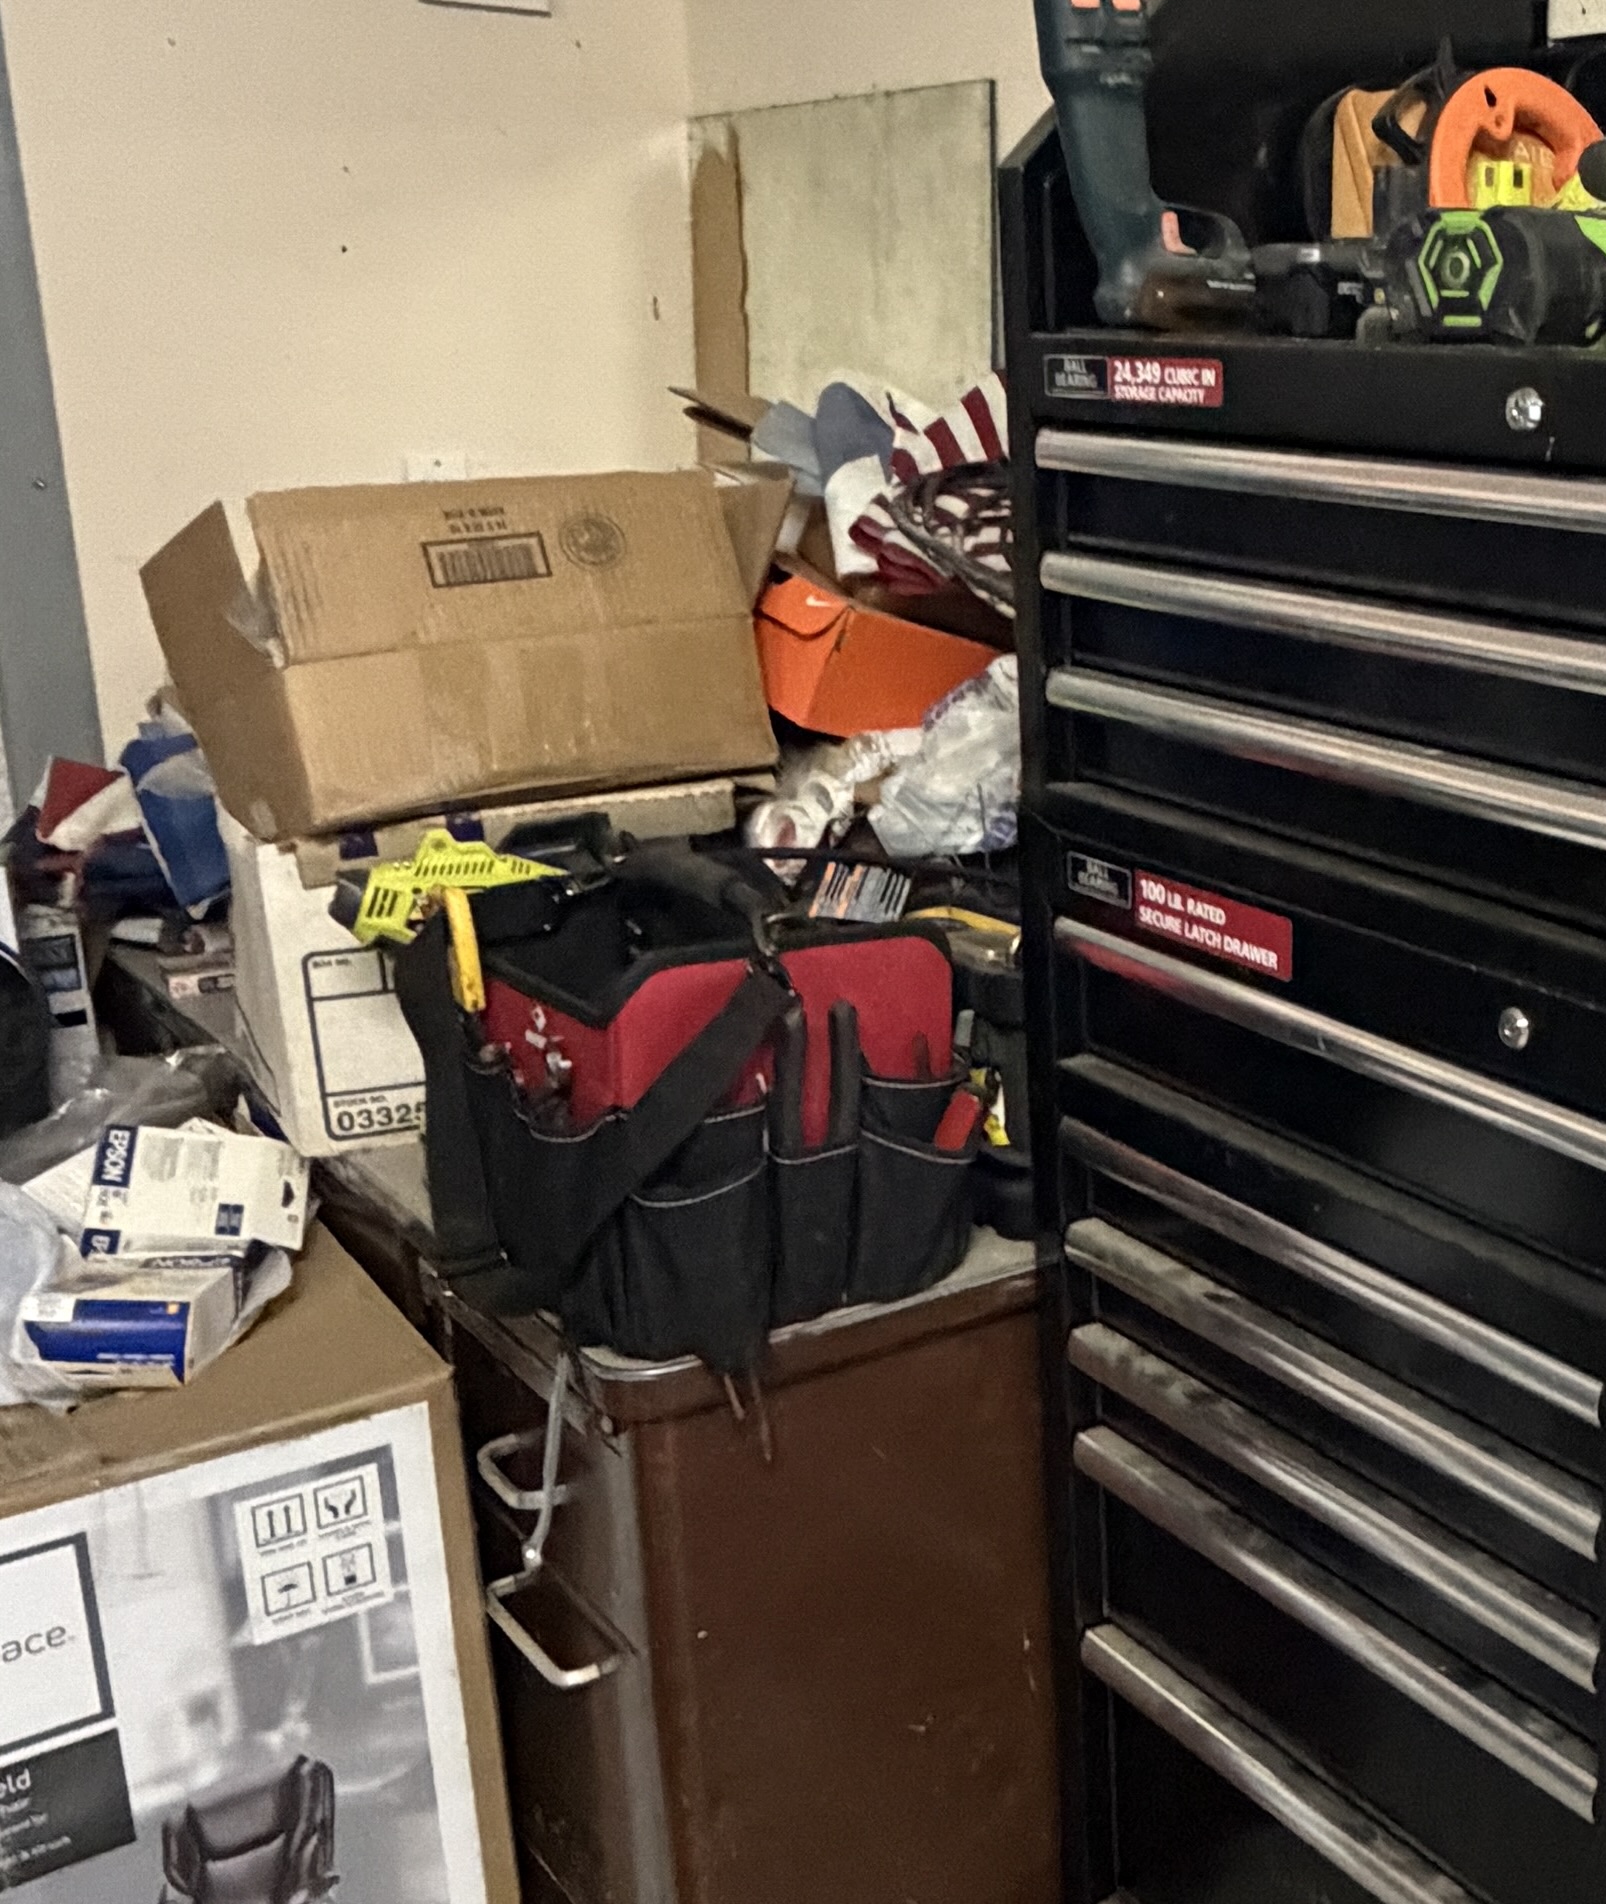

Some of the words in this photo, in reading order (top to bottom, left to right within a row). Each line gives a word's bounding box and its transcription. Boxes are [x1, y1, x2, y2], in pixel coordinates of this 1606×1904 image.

[1113, 359, 1162, 386] 24,349
[1164, 366, 1199, 387] CUBIC
[1201, 368, 1216, 387] IN
[1114, 386, 1157, 402] STORAGE
[1158, 387, 1204, 405] CAPACITY
[1139, 878, 1165, 905] 100
[1187, 897, 1226, 926] RATED
[1139, 905, 1183, 936] SECURE
[1184, 921, 1221, 950] LATCH
[1223, 936, 1278, 971] DRAWER
[101, 1129, 131, 1183] EPSON
